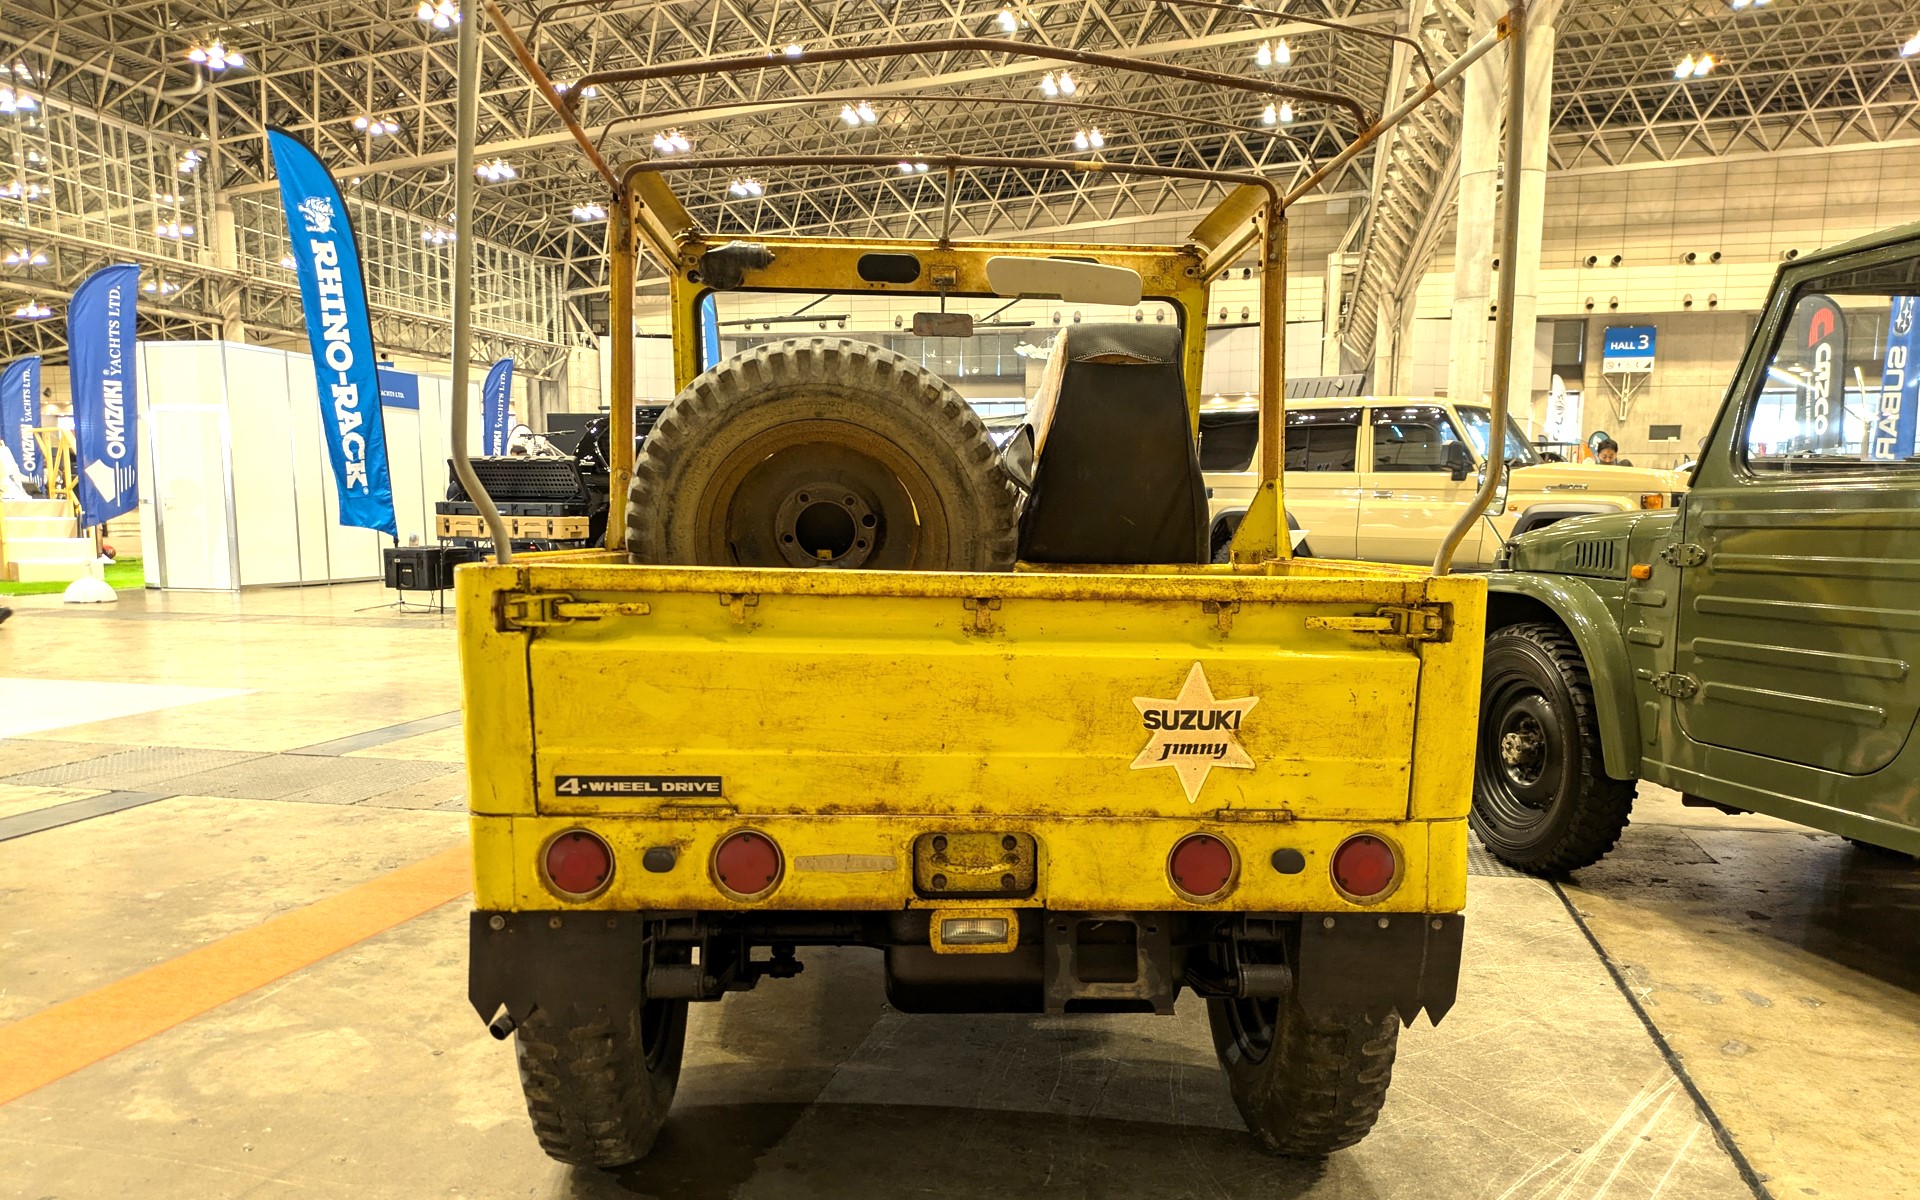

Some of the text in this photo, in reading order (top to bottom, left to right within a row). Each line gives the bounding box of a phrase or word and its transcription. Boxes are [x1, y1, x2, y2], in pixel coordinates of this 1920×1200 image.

[1610, 334, 1649, 350] HALL 3
[102, 285, 126, 459] OKAZAKI YACHTS LTD.
[310, 238, 368, 489] RHINO-RACK
[1143, 709, 1241, 731] SUZUKI
[661, 781, 720, 792] DRIVE
